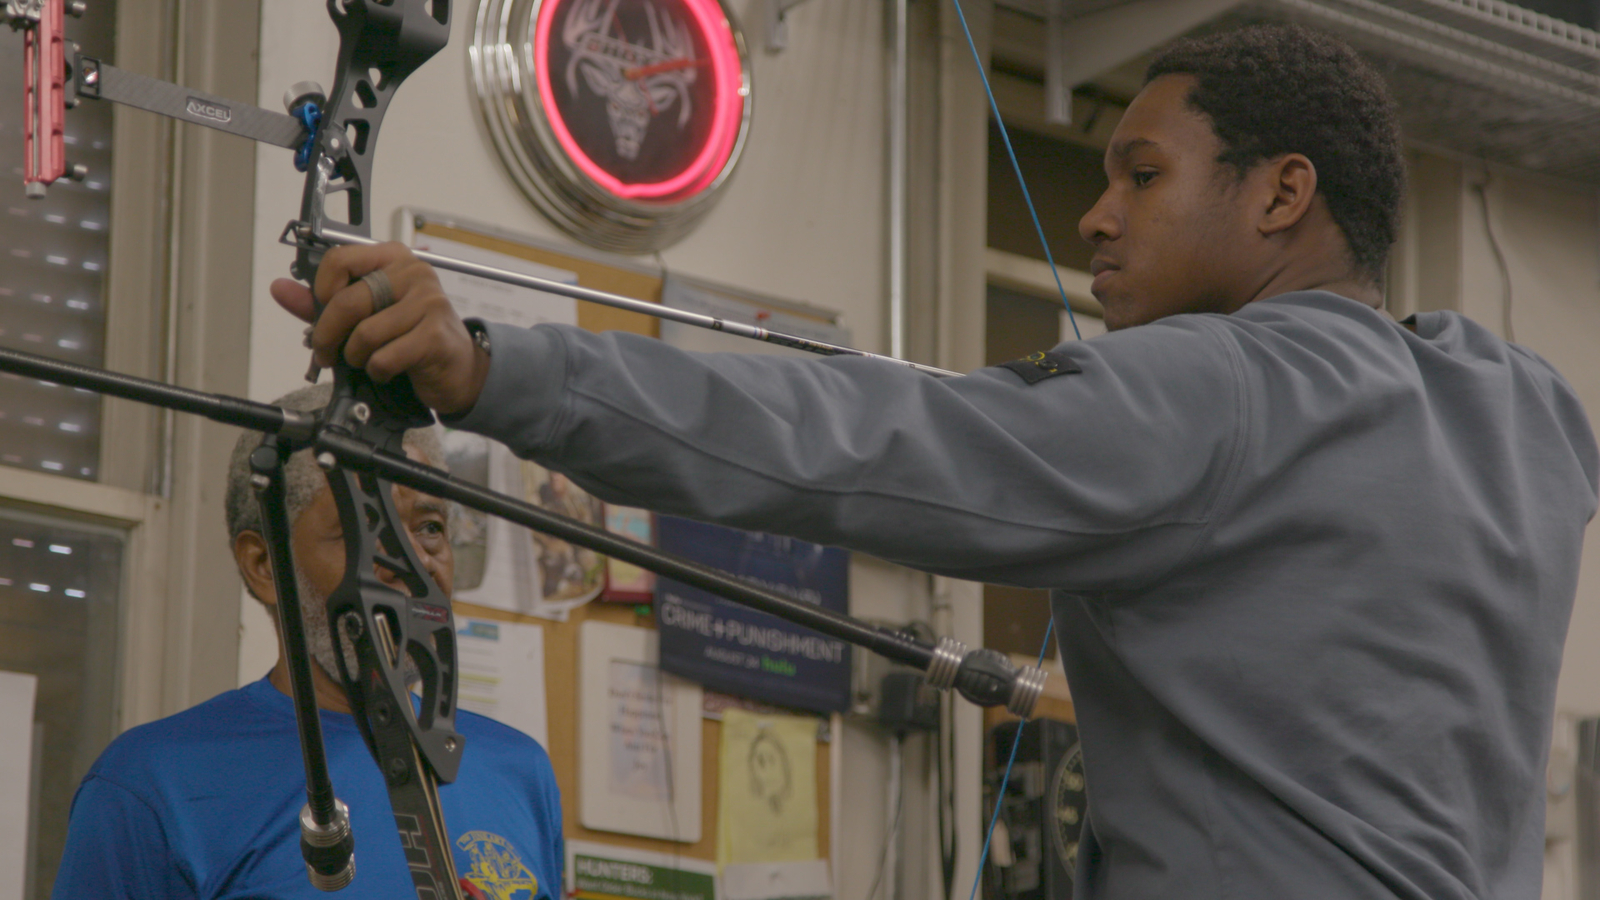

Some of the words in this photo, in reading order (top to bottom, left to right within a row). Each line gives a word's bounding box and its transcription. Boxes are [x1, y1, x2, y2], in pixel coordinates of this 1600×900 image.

[187, 101, 230, 120] AXCEL
[761, 655, 797, 676] hulu
[577, 858, 654, 884] HUNTERS:
